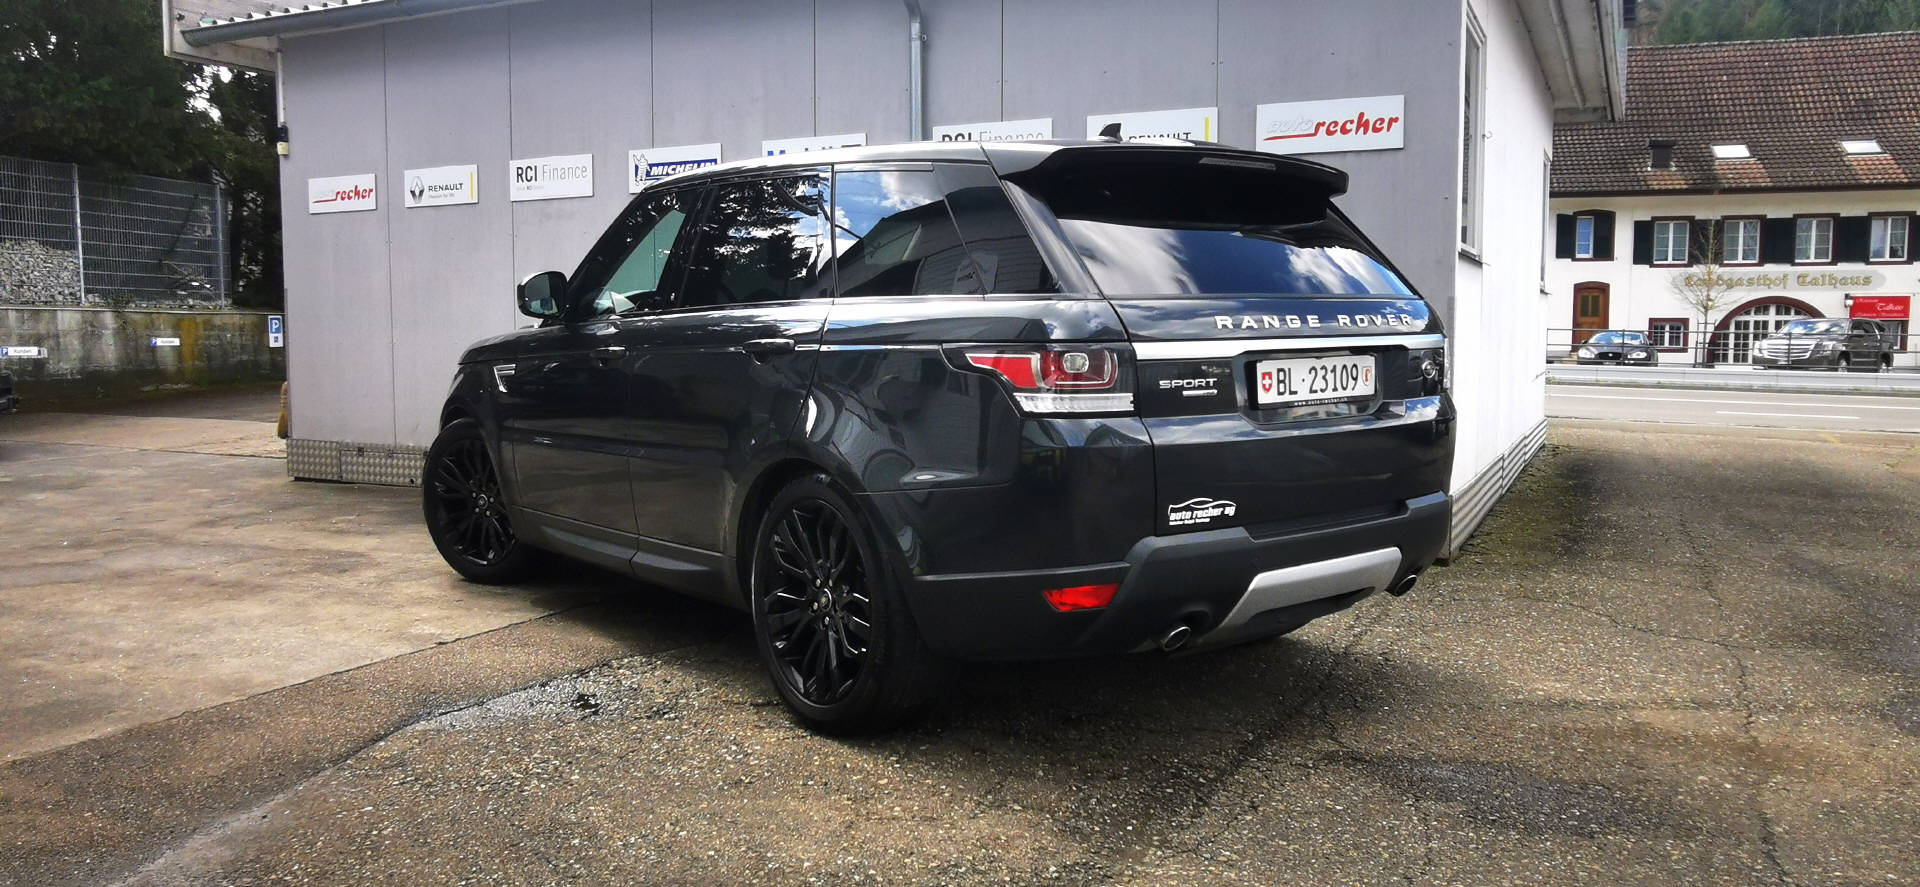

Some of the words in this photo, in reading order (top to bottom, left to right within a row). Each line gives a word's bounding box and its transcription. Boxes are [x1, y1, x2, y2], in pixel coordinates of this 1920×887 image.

[516, 165, 538, 183] RCI
[542, 163, 588, 183] Finance
[428, 182, 464, 193] RENAULT
[1796, 272, 1873, 289] Talhaus
[1214, 314, 1322, 330] RANGE
[1337, 313, 1413, 328] ROVER
[1159, 378, 1218, 389] SPORT
[1169, 510, 1192, 521] auto
[1192, 507, 1224, 519] recher
